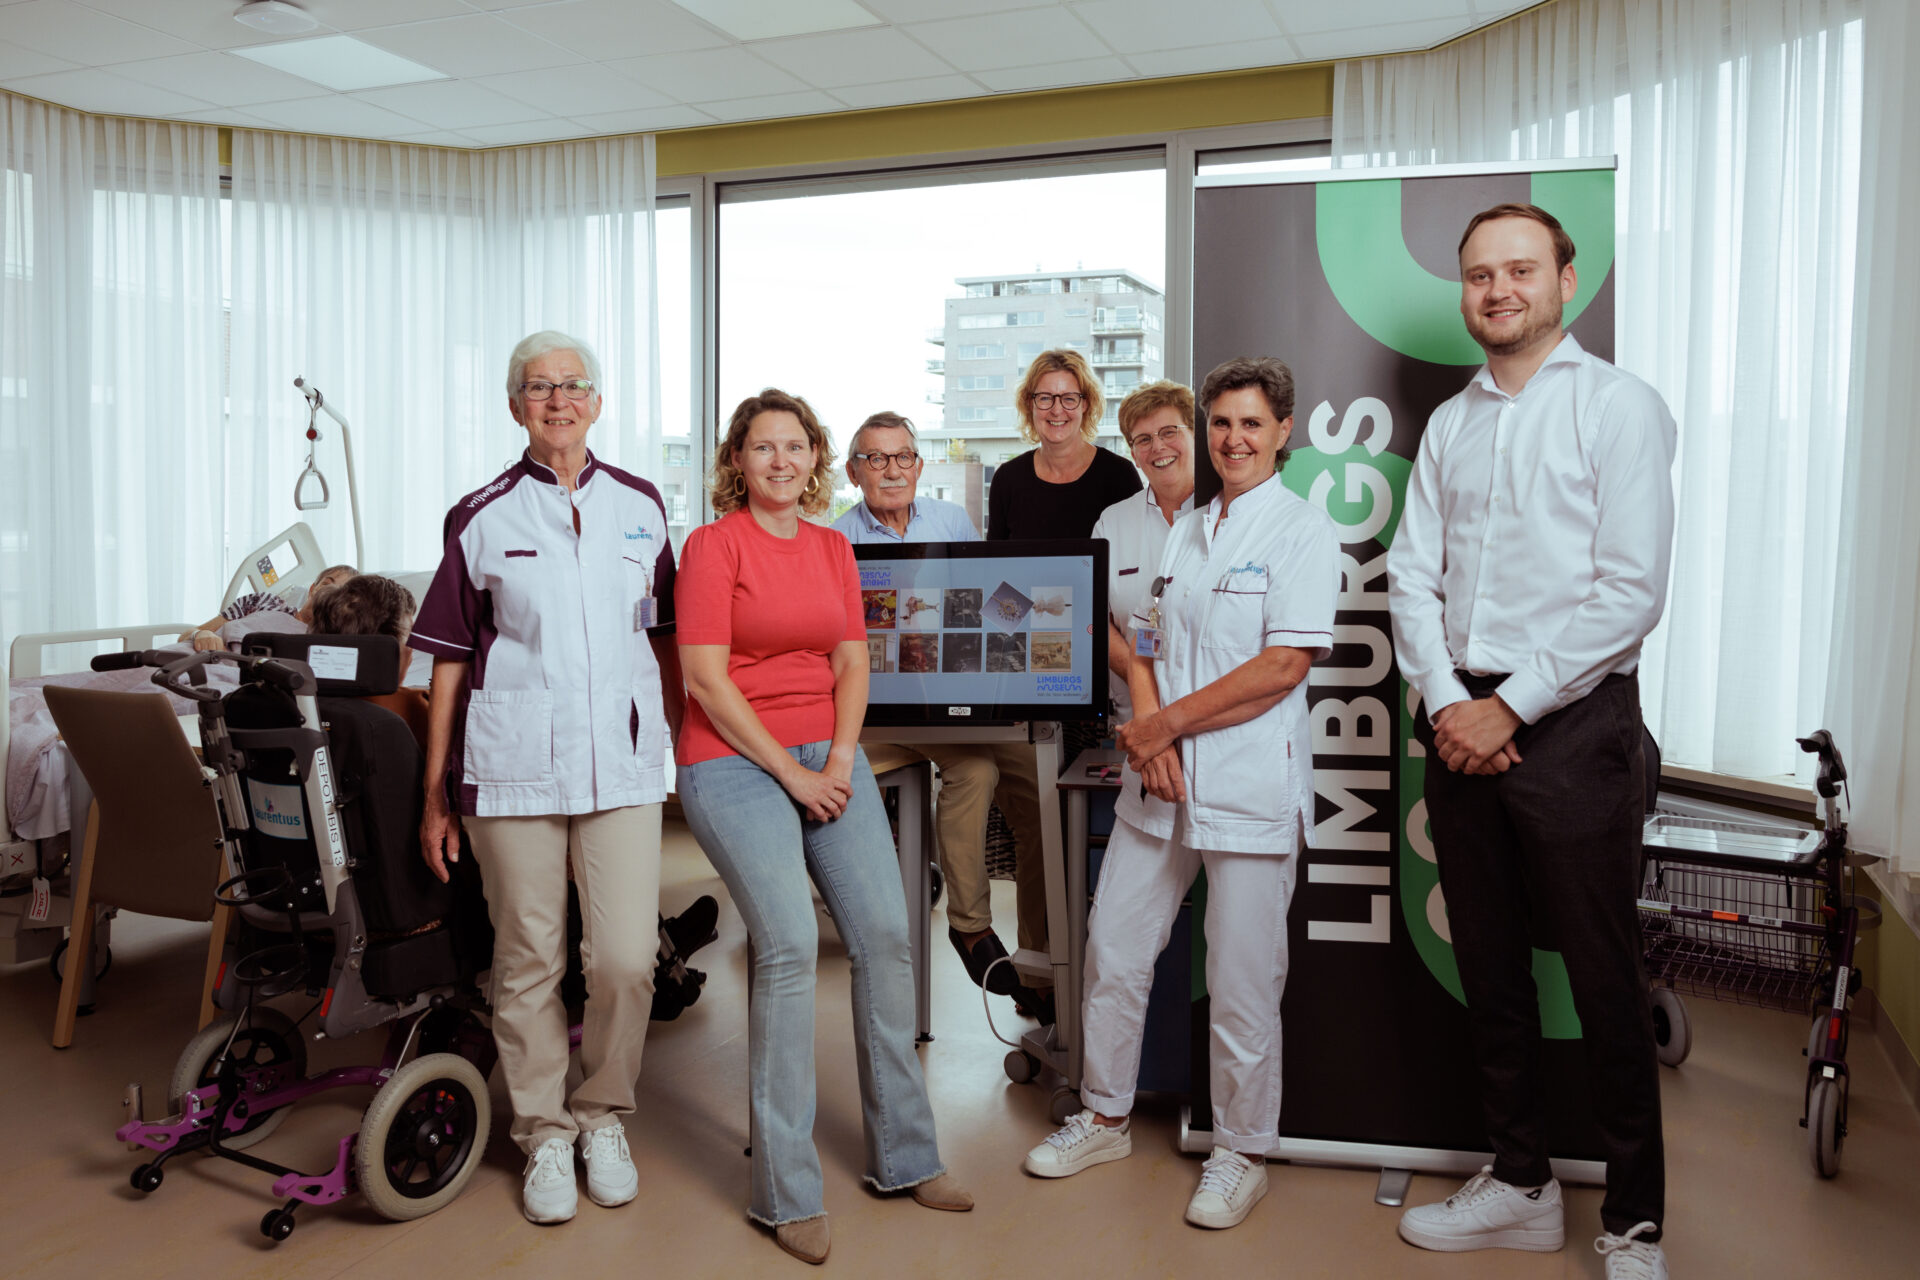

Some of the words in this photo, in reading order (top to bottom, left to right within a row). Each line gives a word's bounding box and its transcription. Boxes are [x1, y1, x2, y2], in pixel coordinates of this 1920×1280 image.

[467, 477, 510, 508] vrijwilliger
[1037, 675, 1082, 684] LIMBURGS
[1308, 397, 1393, 945] LIMBURGS
[317, 750, 334, 804] DEPOT
[333, 849, 343, 866] 13
